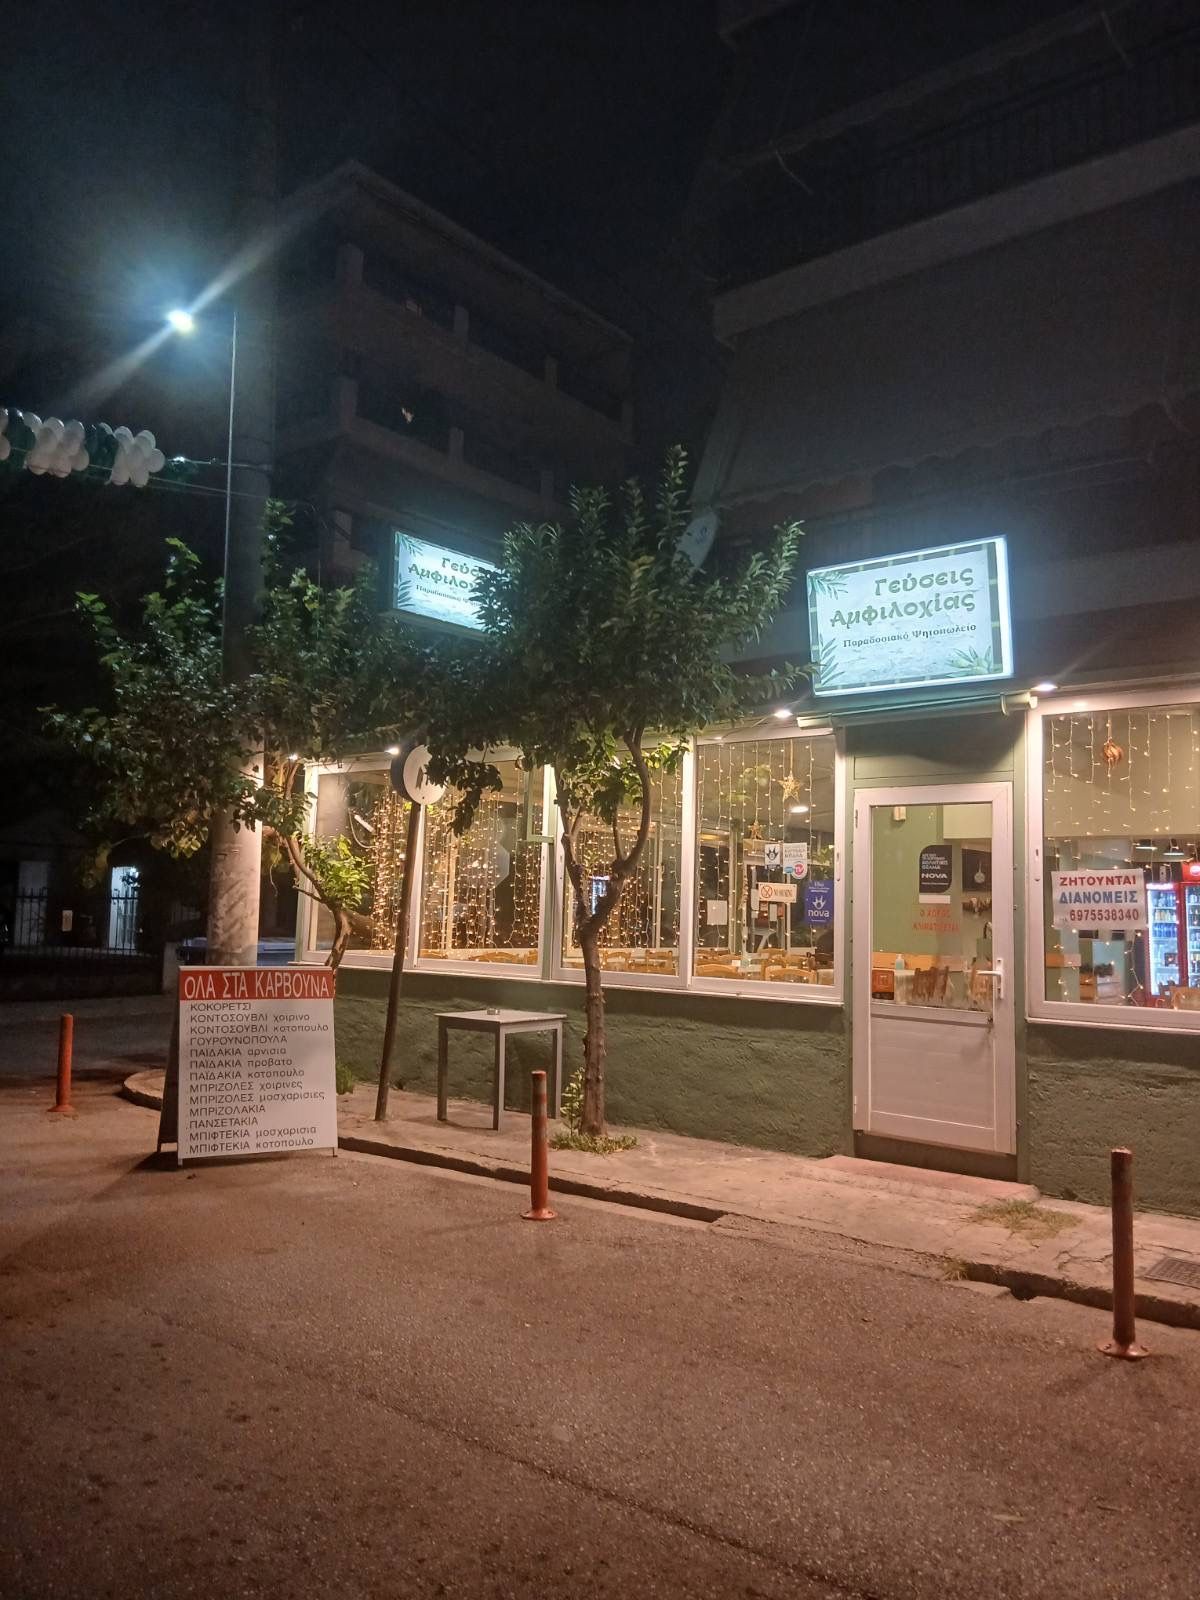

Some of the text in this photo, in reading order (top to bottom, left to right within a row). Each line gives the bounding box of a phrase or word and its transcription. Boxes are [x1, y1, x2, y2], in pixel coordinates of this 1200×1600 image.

[875, 568, 974, 596] Γεύσεις
[830, 592, 976, 629] Αμφιλοχίας
[843, 633, 909, 648] Παραδοσιακό
[1059, 875, 1136, 887] ΖΗΤΟΥΝΤΑΙ
[1059, 890, 1138, 904] ΔΙΑΝΟΜΕΙΣ
[807, 909, 830, 918] nova
[1069, 908, 1139, 921] 6975538340
[184, 971, 330, 999] ΟΛΑ ΣΤΑ ΚΑΡΒΟΥΝΑ
[190, 1002, 252, 1012] ΚΟΚΟΡΕΤΣΙ
[190, 1014, 310, 1023] ΚΟΝΤΟΣΟΥΒΛΙ χοιρινο
[190, 1024, 329, 1034] ΚΟΝΤΟΣΟΥΒΛΙ κοτοπουλο
[190, 1035, 288, 1046] ΓΟΥΡΟΥΝΟΠΟΥΛΑ
[247, 1047, 287, 1057] αρνισια
[247, 1058, 293, 1068] προβατο
[247, 1069, 305, 1079] κοτοπουλο
[189, 1080, 303, 1093] ΜΠΡΙΖΟΛΕΣ χοιρινες
[189, 1091, 325, 1105] ΜΠΡΙΖΟΛΕΣ μοσχαρισιες
[189, 1104, 266, 1117] ΜΠΡΙΖΟΛΑΚΙΑ
[189, 1117, 259, 1129] ΠΑΝΣΕΤΑΚΙΑ
[189, 1126, 317, 1142] ΜΠΙΦΤΕΚΙΑ μοσχαρισια
[189, 1137, 314, 1154] ΜΠΙΦΤΕΚΙΑ κοτοπουλο
